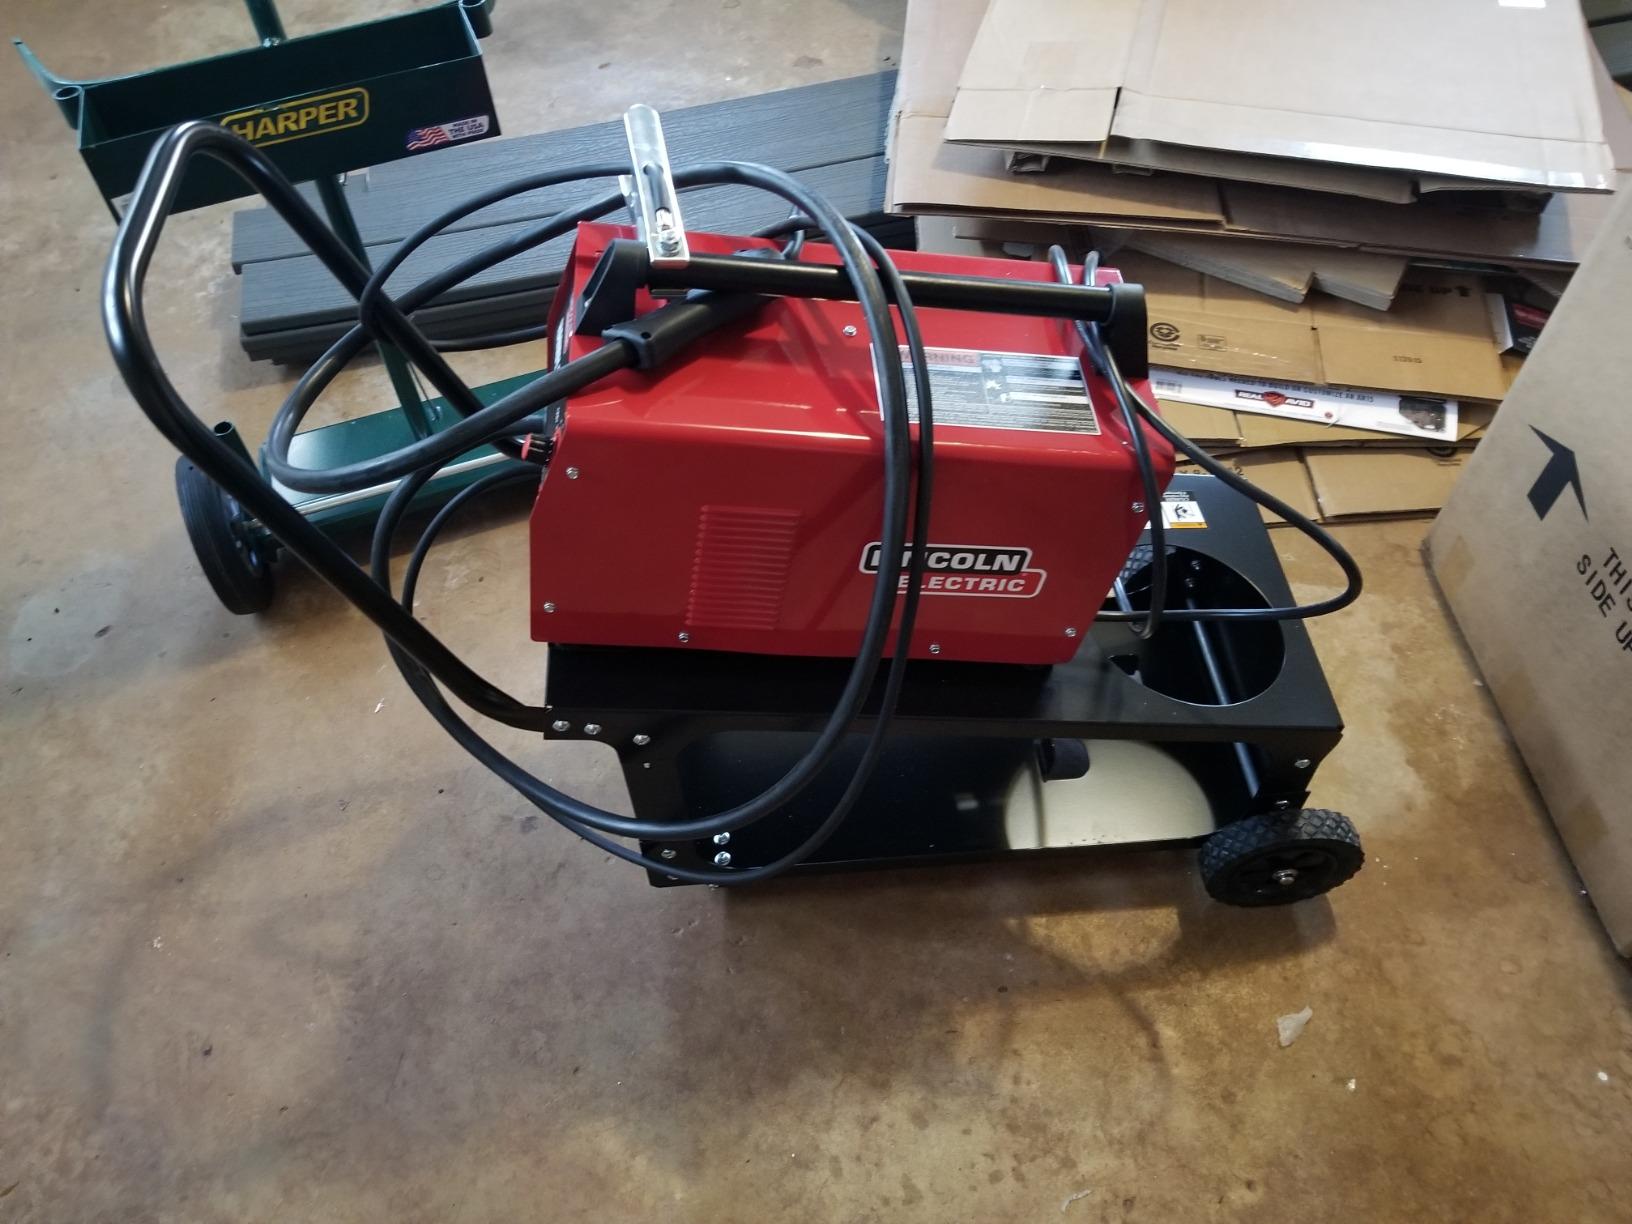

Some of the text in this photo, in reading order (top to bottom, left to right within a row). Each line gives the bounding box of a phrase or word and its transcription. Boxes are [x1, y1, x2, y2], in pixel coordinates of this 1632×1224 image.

[231, 98, 358, 141] HARPER
[1238, 391, 1312, 408] REAL AVID
[898, 575, 1026, 592] EECTRIC
[1577, 554, 1616, 618] SIDE
[1603, 546, 1632, 612] THI
